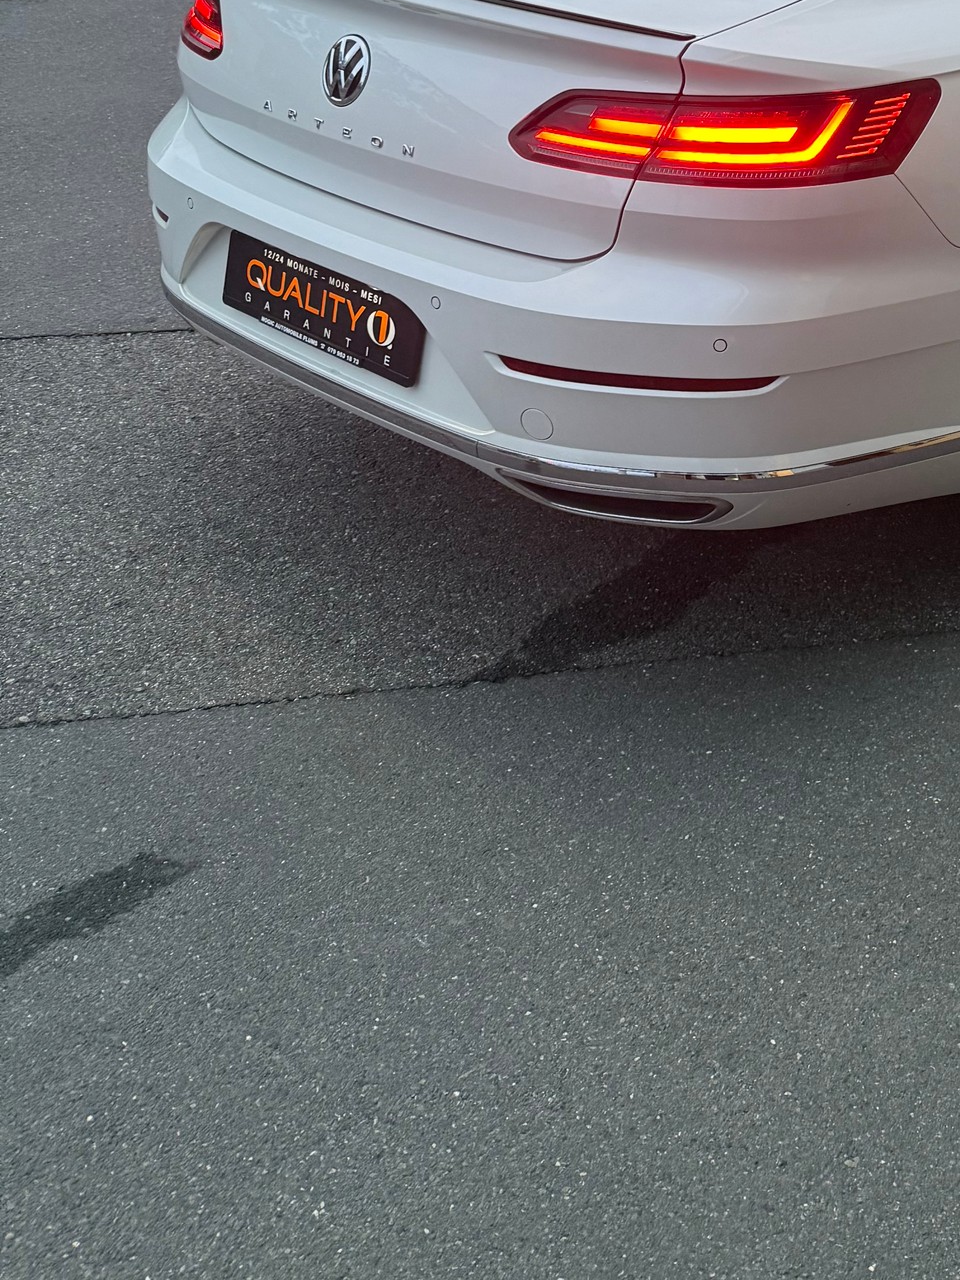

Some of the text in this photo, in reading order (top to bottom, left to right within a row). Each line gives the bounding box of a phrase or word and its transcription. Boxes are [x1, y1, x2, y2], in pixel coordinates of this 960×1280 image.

[263, 99, 415, 157] ARTEON
[246, 259, 366, 331] QUALITY
[263, 248, 284, 264] 12/24
[286, 258, 319, 279] MONATE
[328, 276, 350, 292] MOIS
[360, 289, 382, 305] MESI
[245, 292, 391, 367] GARANTIE
